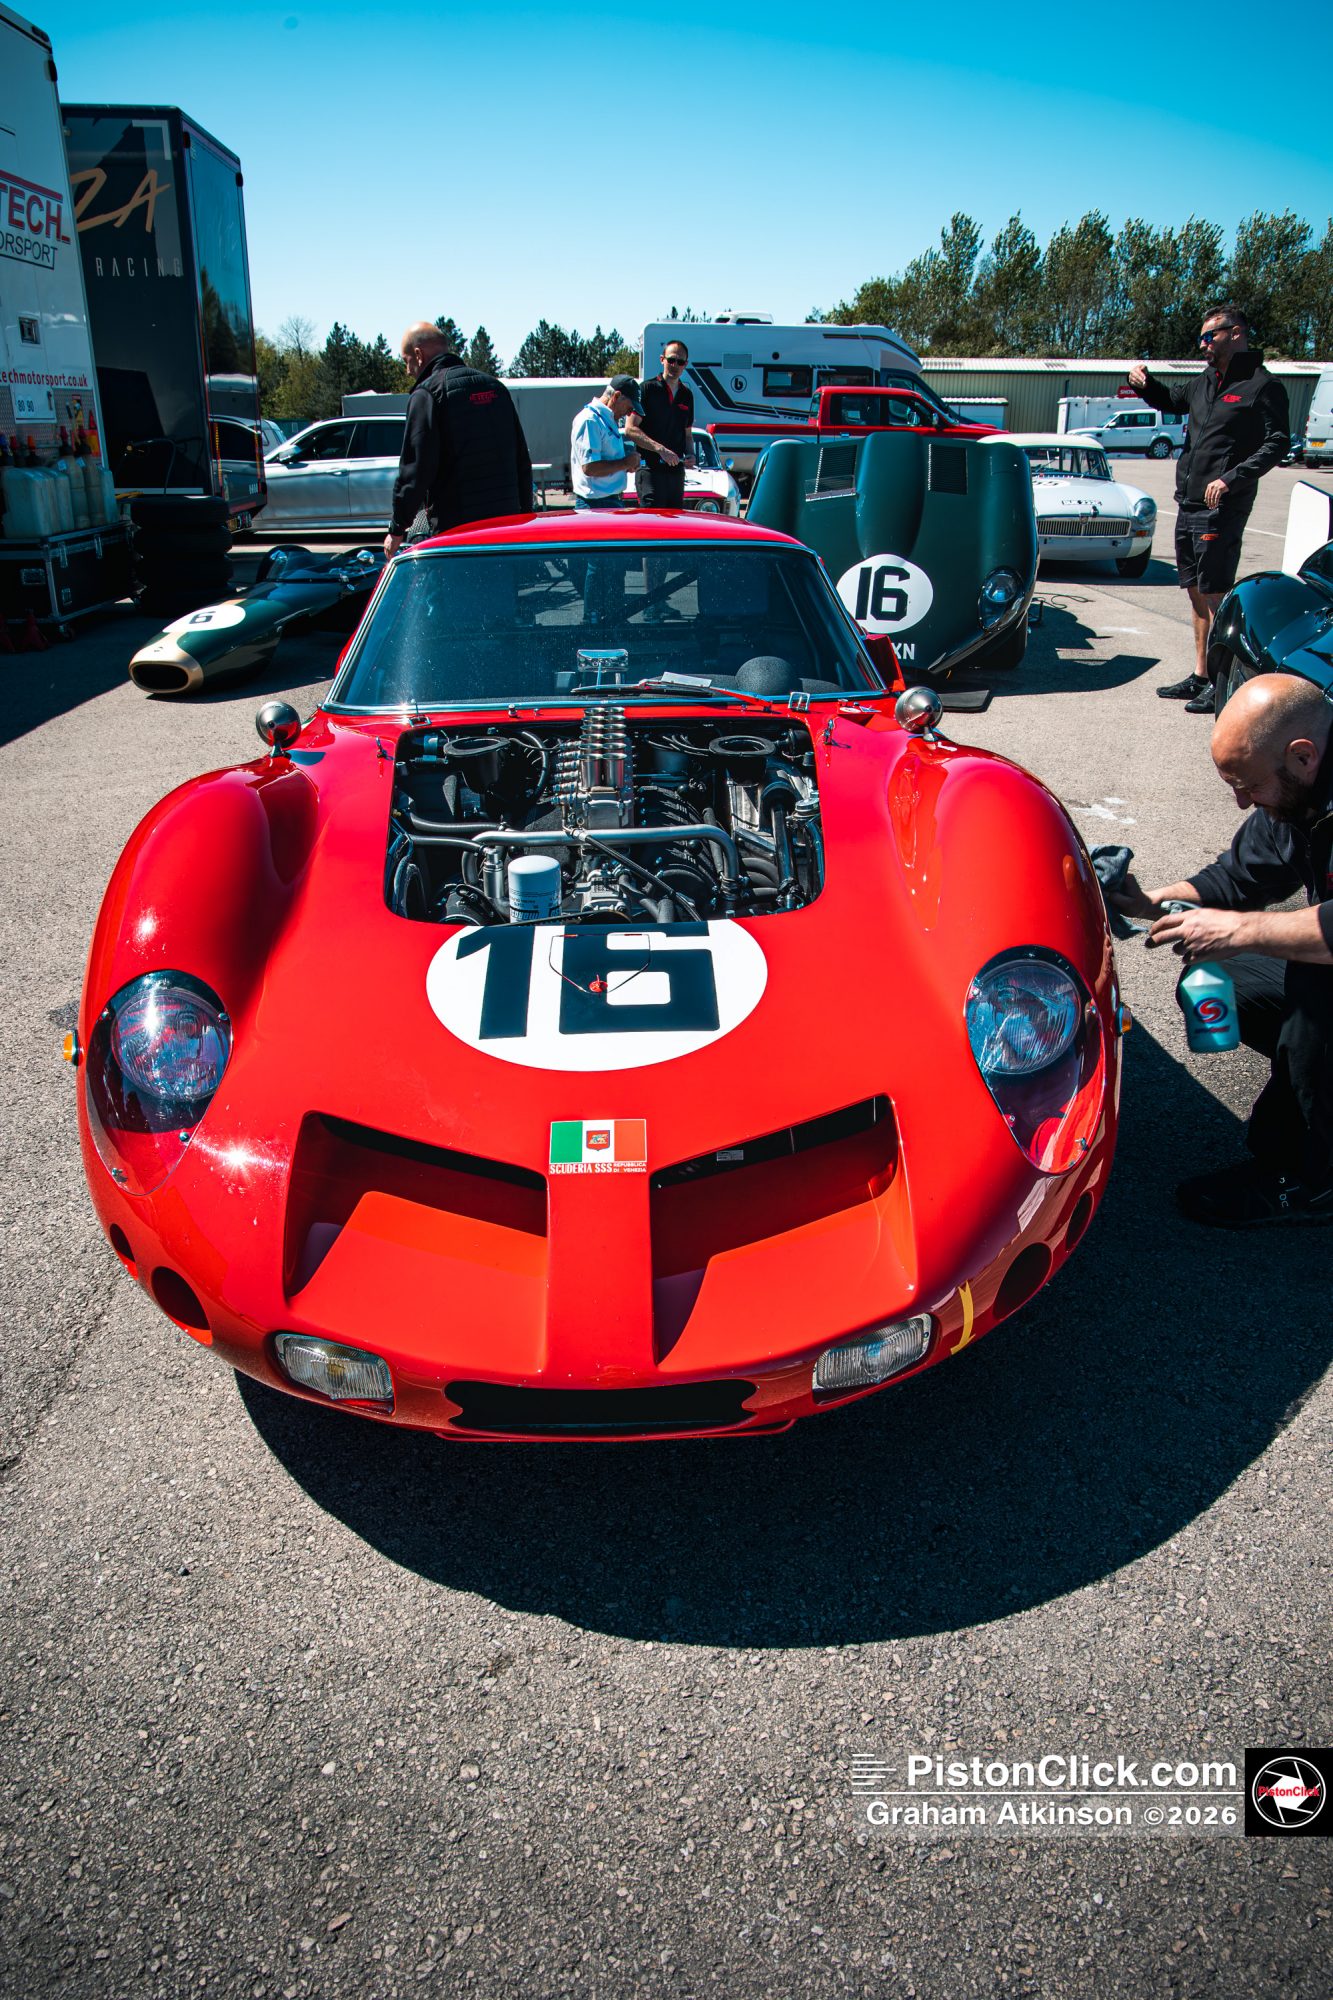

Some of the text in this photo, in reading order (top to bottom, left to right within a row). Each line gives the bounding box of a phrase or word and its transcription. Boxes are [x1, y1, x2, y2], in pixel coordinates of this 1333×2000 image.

[95, 257, 182, 278] RACING
[0, 368, 88, 387] echmotorsport.co.uk
[855, 565, 910, 622] 16
[189, 610, 216, 625] 6
[455, 921, 720, 1040] 16
[550, 1163, 613, 1174] SCUDERIA SSS
